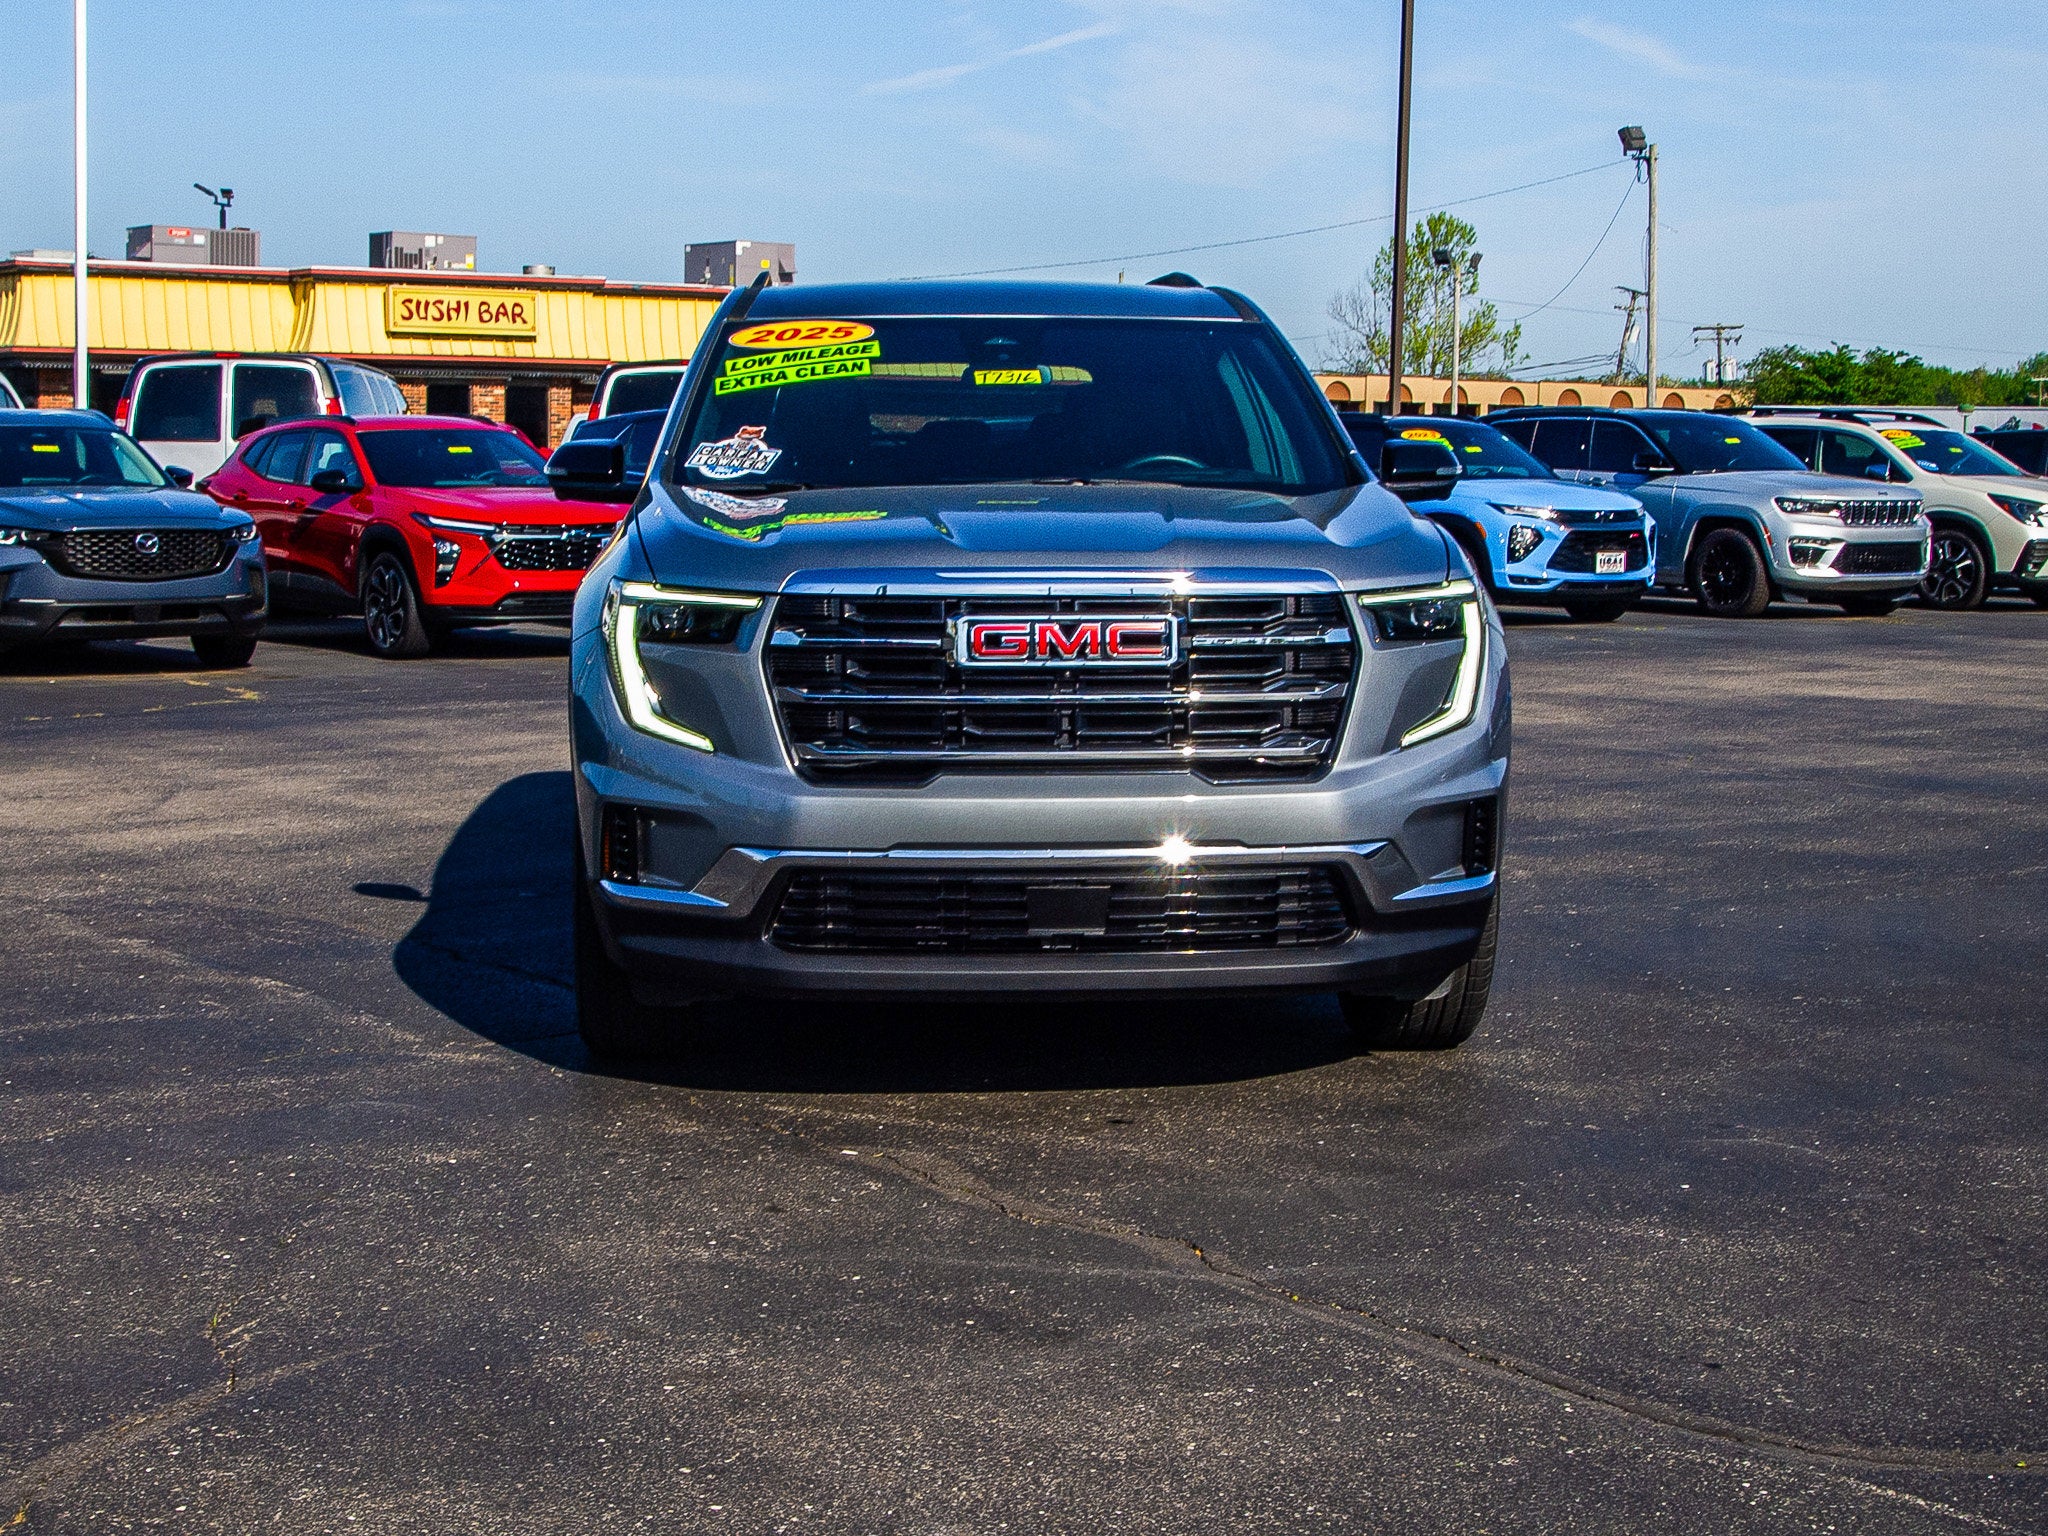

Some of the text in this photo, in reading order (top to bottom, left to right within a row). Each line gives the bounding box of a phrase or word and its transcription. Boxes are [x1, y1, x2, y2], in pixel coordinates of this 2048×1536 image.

[401, 298, 528, 325] SUSHI BAR
[746, 326, 857, 344] 2025
[730, 343, 875, 372] LOW MILEAGE
[719, 361, 865, 391] EXTRA CLEAN
[972, 622, 1166, 660] GMC
